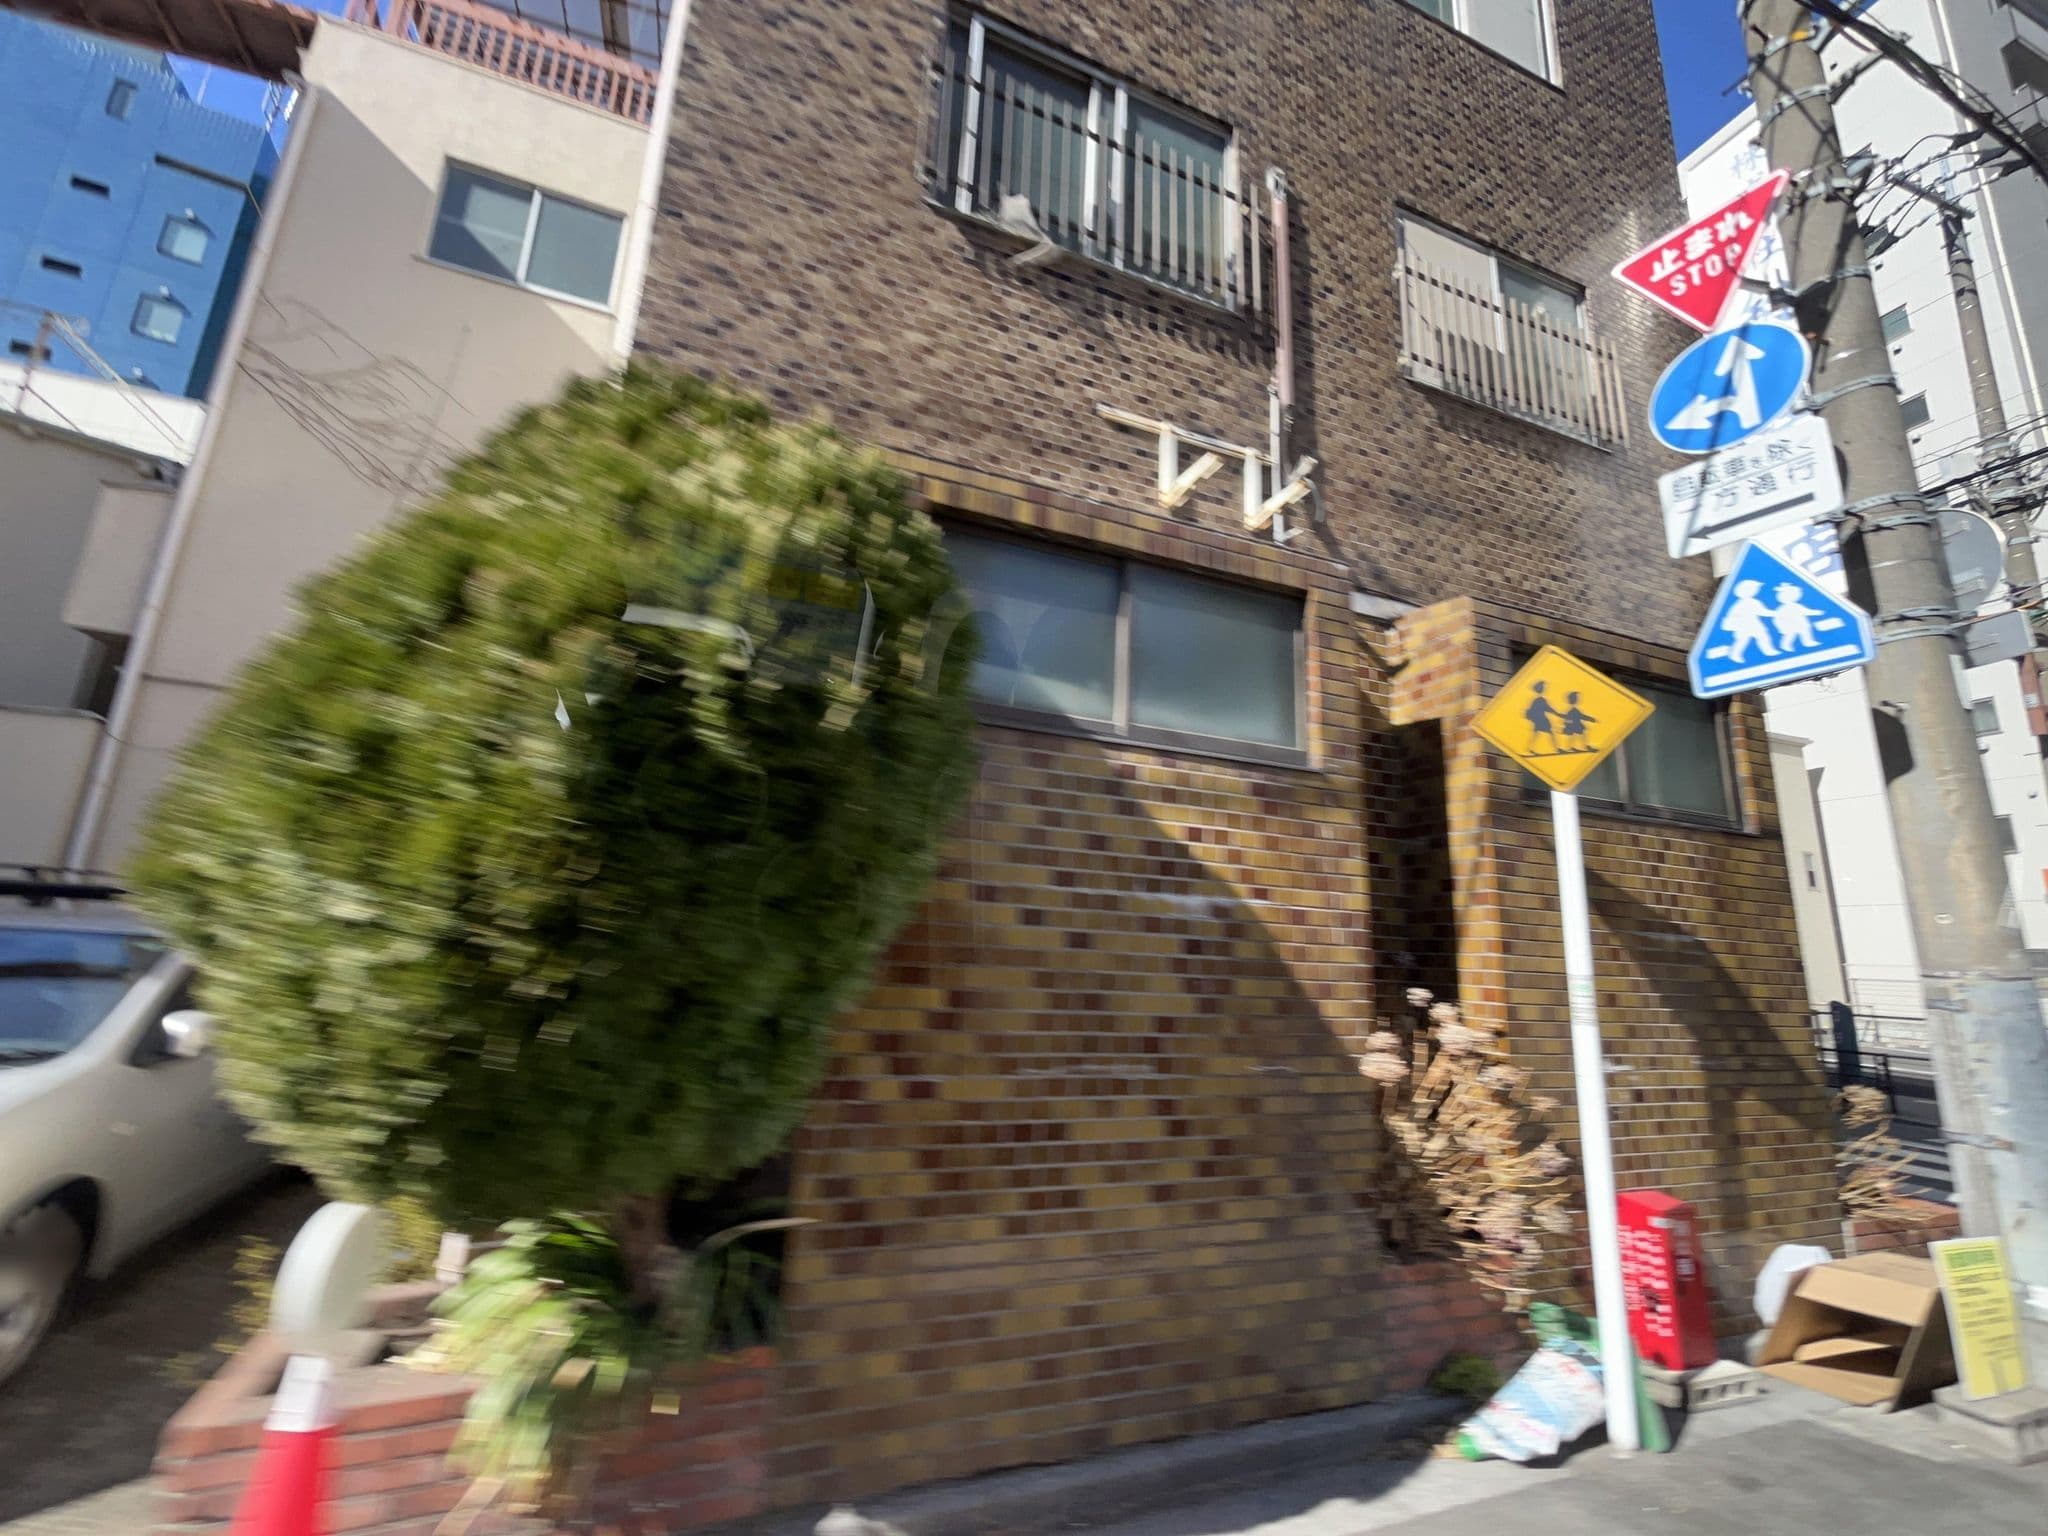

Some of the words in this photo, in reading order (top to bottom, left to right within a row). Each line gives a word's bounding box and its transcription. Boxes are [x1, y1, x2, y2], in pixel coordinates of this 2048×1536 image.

[1649, 211, 1755, 282] 止まれ
[1668, 242, 1742, 297] STOP
[1678, 455, 1817, 514] 一方通行
